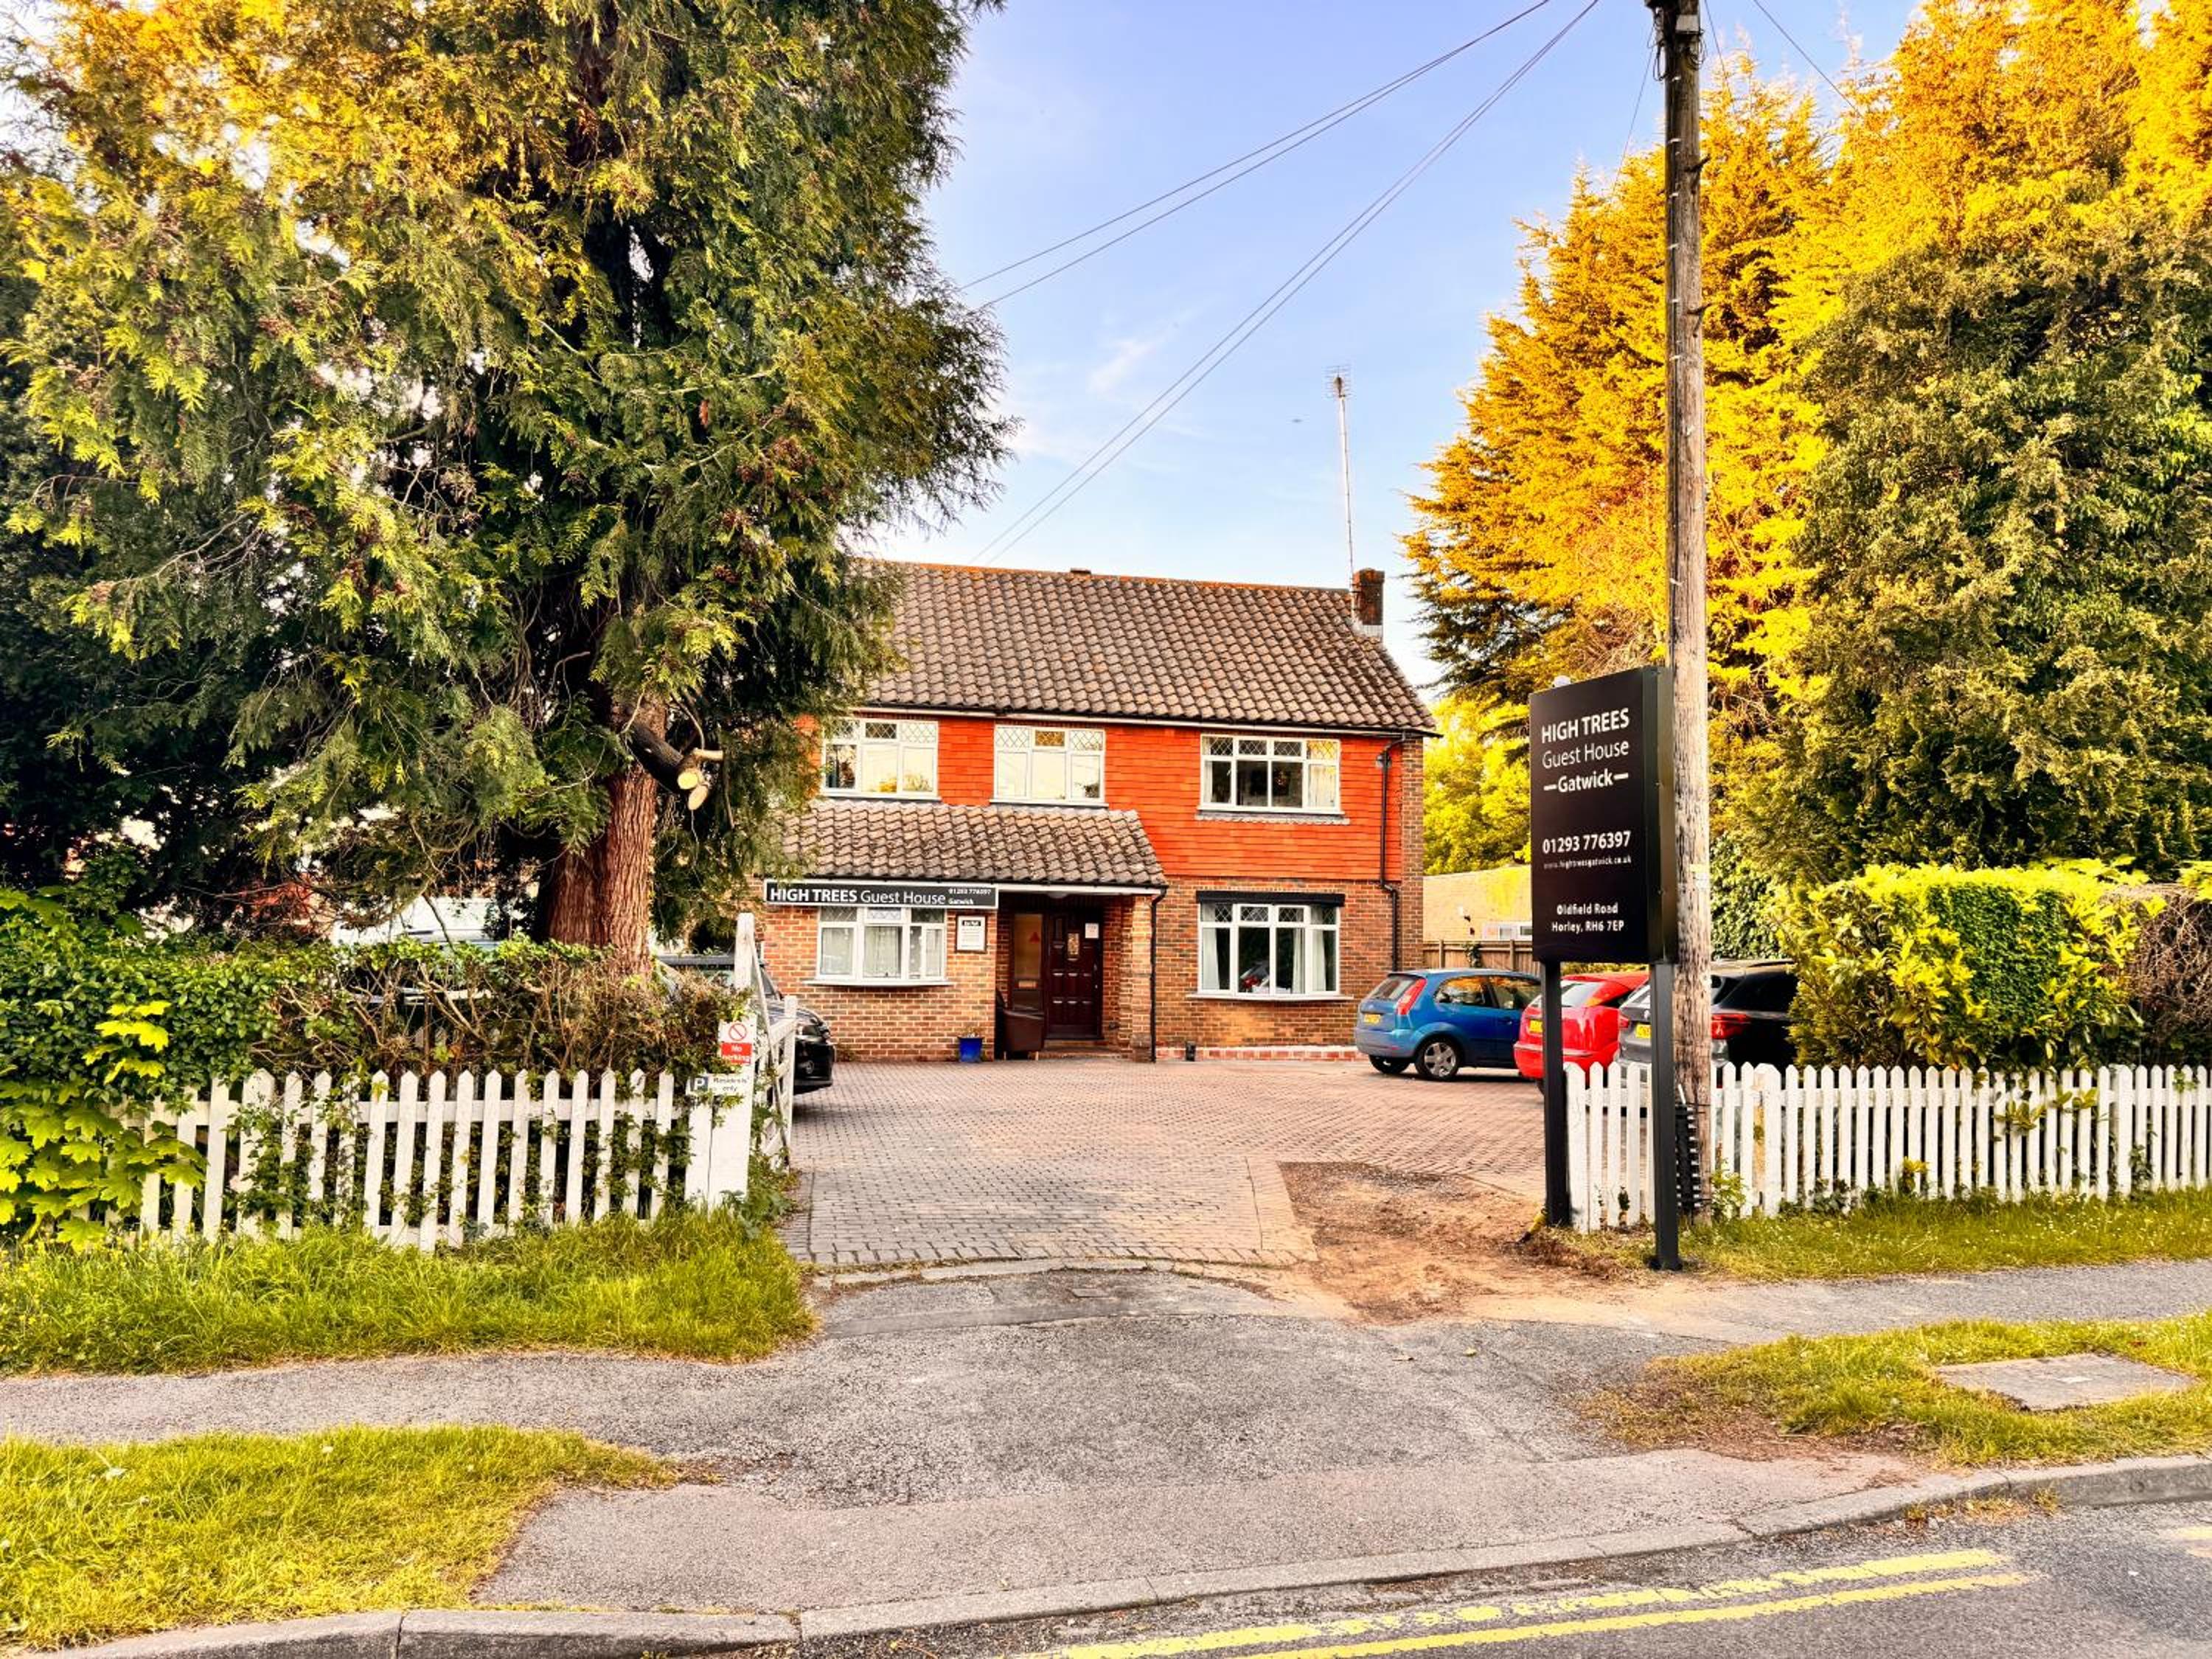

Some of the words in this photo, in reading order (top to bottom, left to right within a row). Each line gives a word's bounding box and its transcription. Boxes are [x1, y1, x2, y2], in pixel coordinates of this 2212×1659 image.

[1541, 720, 1579, 744] HIGH
[1582, 708, 1630, 736] TREES
[1543, 746, 1581, 769] Guest
[1585, 740, 1630, 762] House
[1543, 835, 1580, 854] 01293
[1583, 831, 1632, 850] 776397
[770, 888, 810, 902] HIGH
[813, 889, 857, 902] TREES
[860, 890, 901, 904] Guest
[903, 891, 946, 905] House
[1557, 903, 1592, 916] Oldfield
[1594, 902, 1618, 914] Road
[1551, 920, 1584, 933] Horley,
[1585, 919, 1604, 932] RH6
[1607, 919, 1625, 931] 7EP
